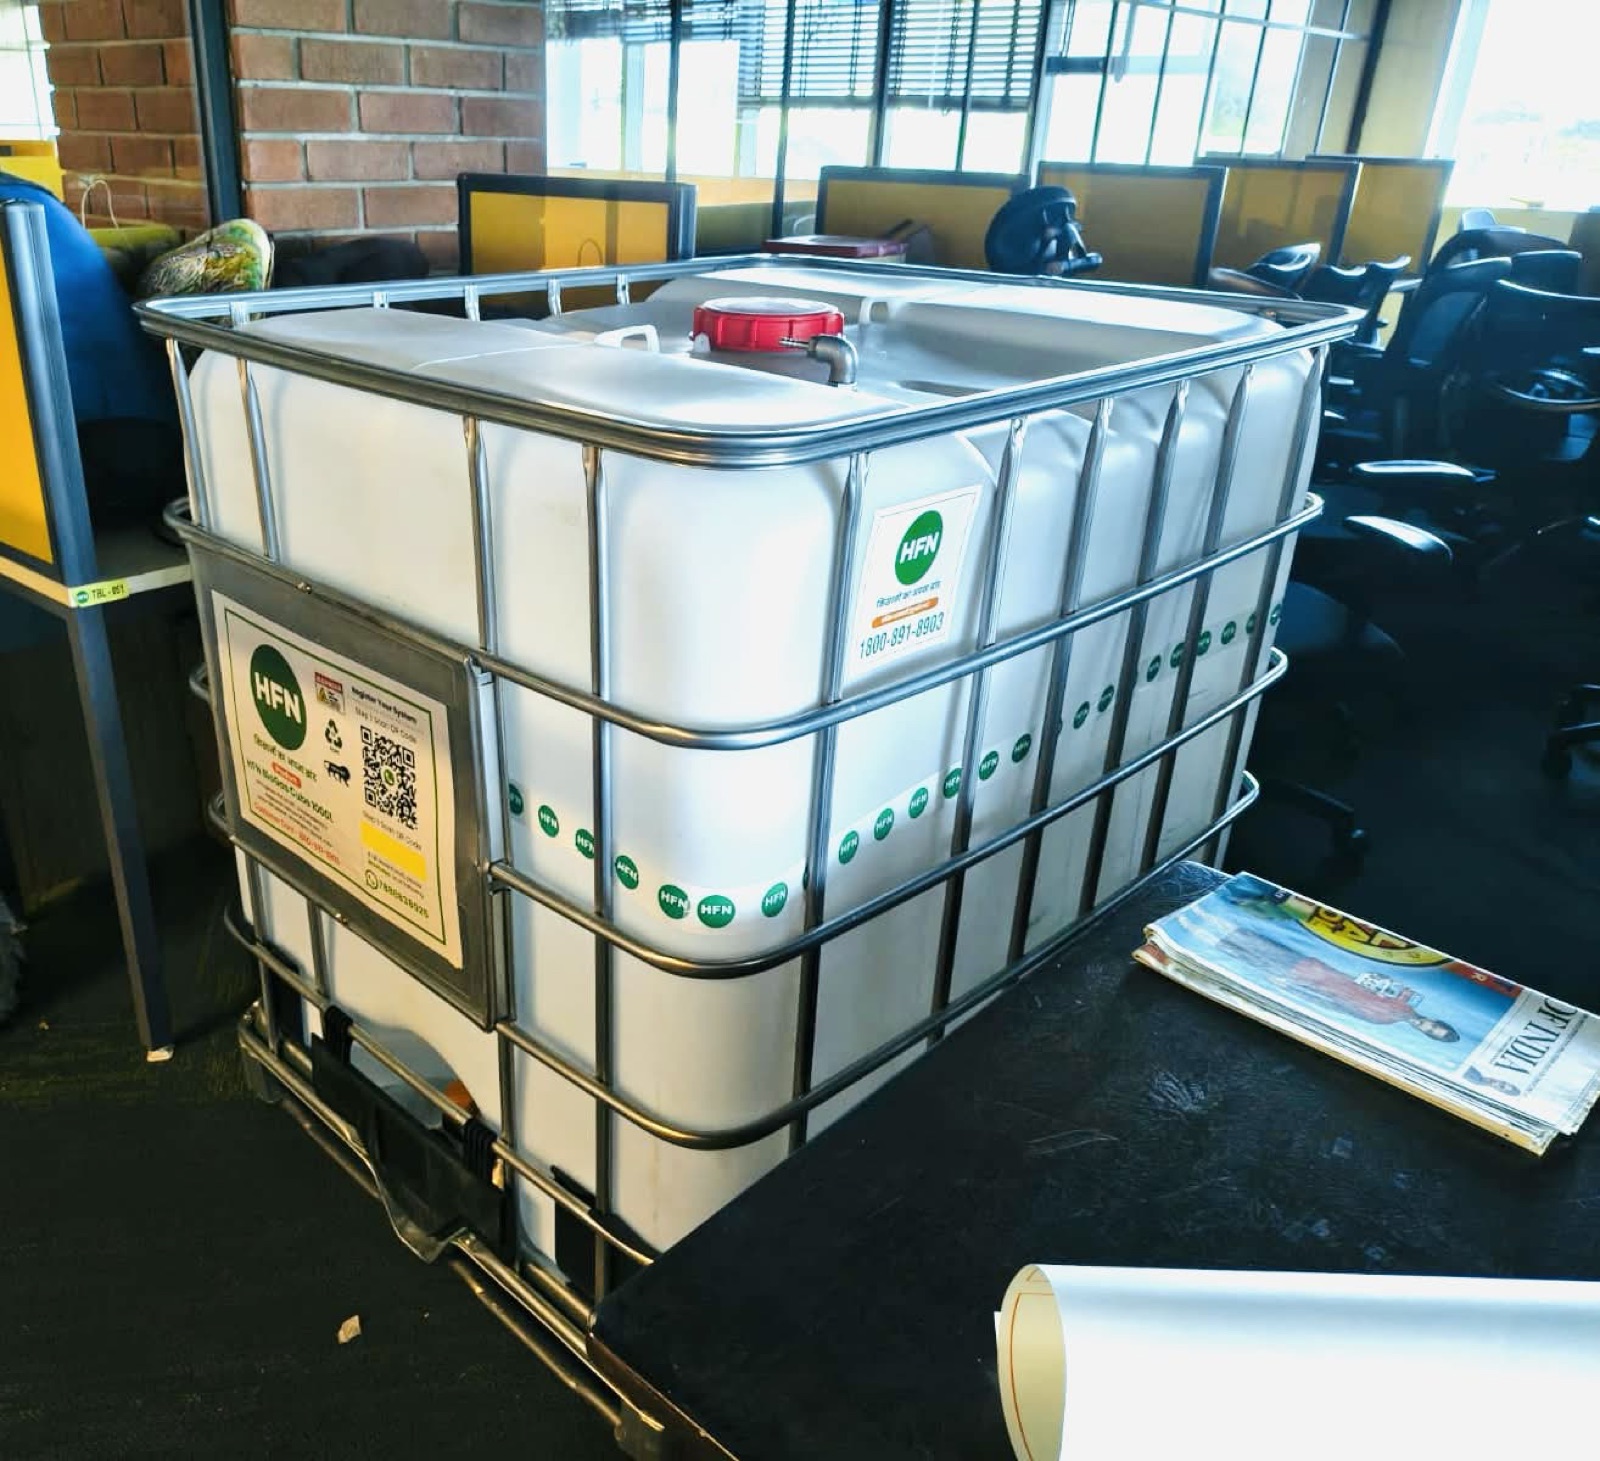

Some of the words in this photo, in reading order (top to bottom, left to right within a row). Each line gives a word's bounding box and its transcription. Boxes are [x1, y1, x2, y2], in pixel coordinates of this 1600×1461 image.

[899, 531, 940, 565] HFN
[859, 611, 945, 660] 1800-891-8903
[254, 671, 302, 723] HFN
[539, 810, 558, 829] HFN
[840, 836, 858, 856] HFN
[616, 860, 638, 881] HFN
[660, 890, 688, 909] HFN
[701, 904, 733, 916] HFN
[765, 887, 786, 907] HFN
[1491, 1020, 1562, 1075] INDIA
